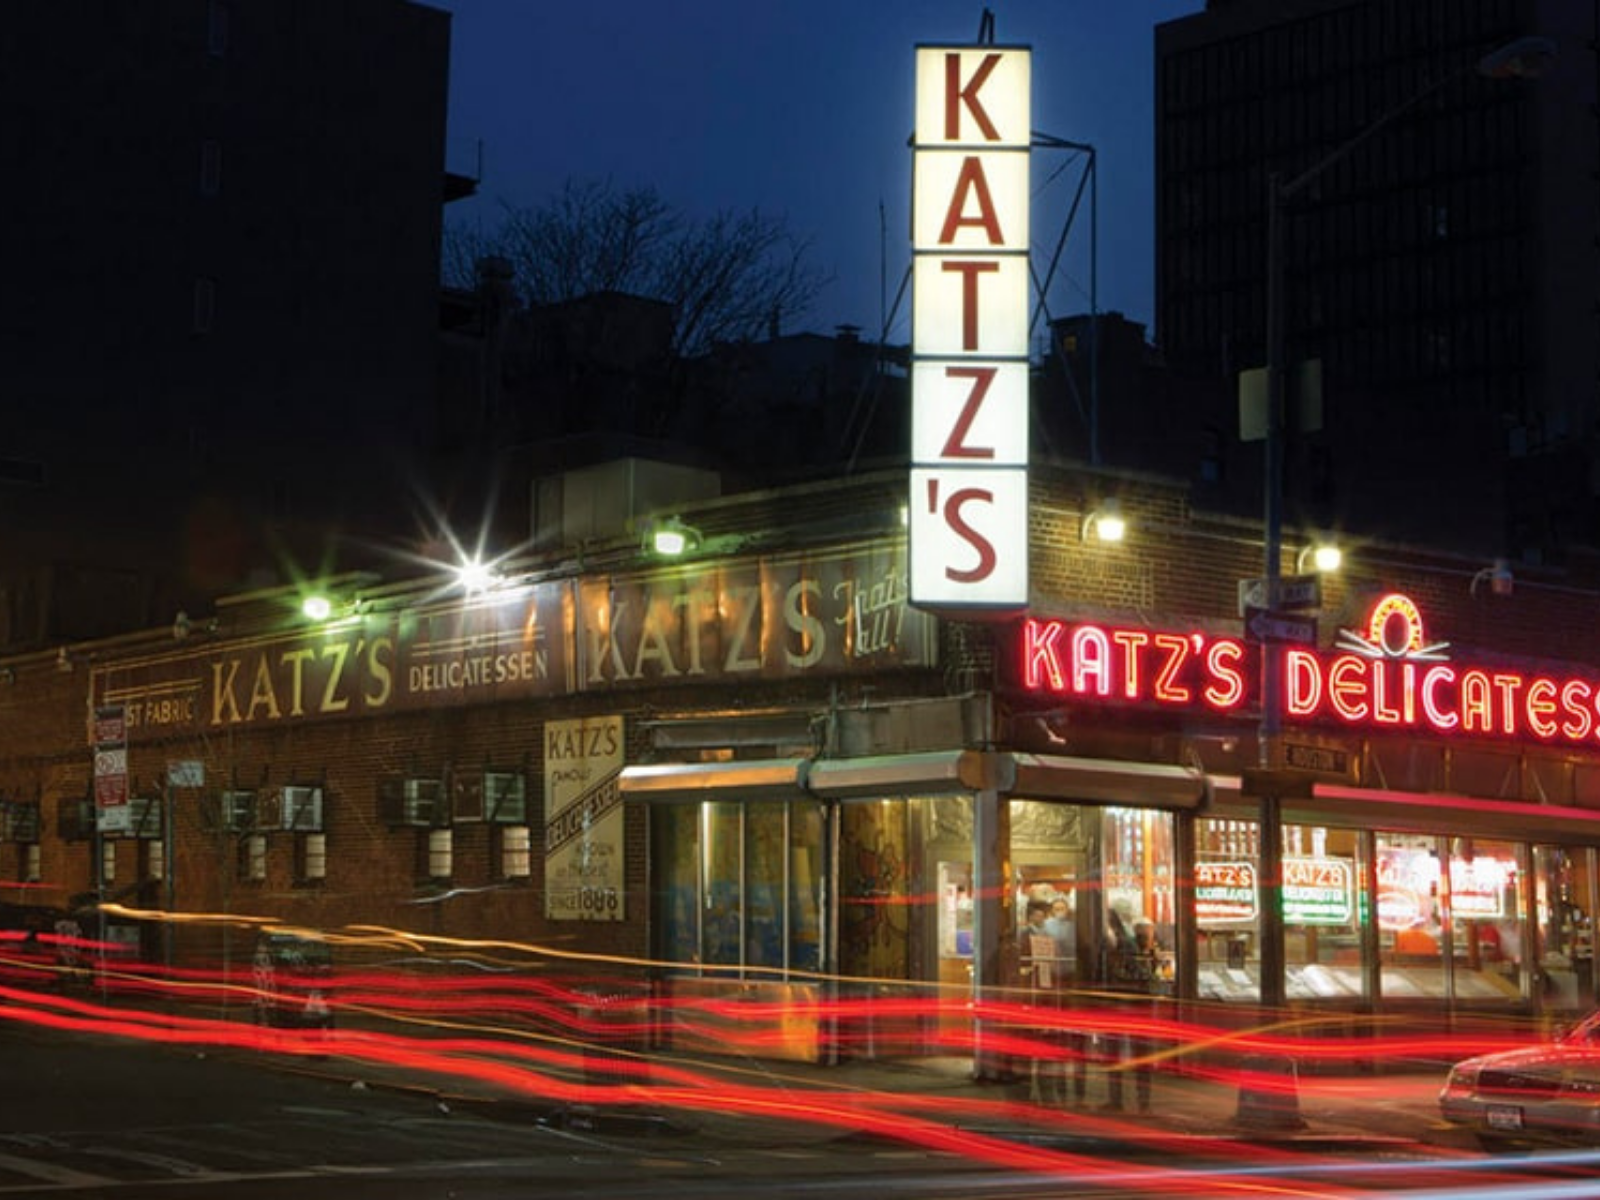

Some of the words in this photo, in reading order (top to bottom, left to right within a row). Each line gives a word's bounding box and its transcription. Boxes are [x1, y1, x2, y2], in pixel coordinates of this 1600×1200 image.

[927, 53, 1004, 584] KATZ'S
[588, 580, 827, 683] KATZ'S
[210, 637, 393, 725] KATZ'S
[409, 650, 548, 693] DELICATESSEN
[1024, 619, 1243, 707] KATZ'S
[1287, 650, 1600, 739] DELICATES
[146, 697, 193, 724] FABRIC
[548, 725, 618, 760] KATZ'S
[1197, 866, 1252, 886] ATZ'S
